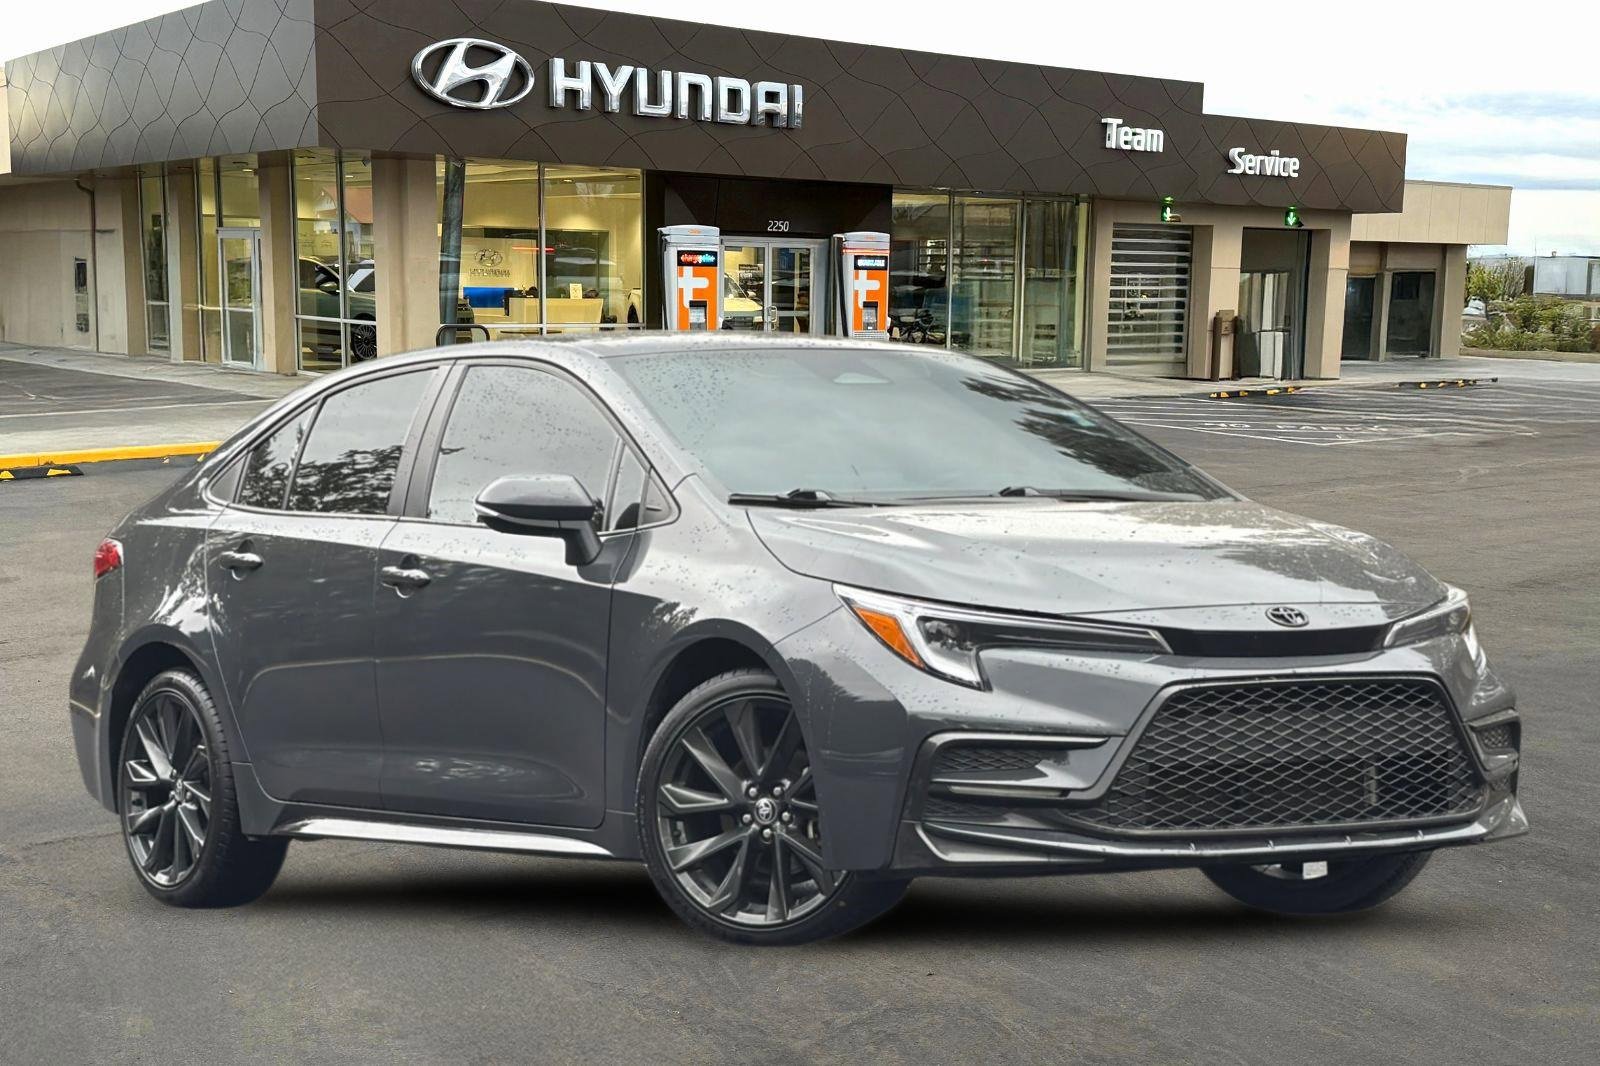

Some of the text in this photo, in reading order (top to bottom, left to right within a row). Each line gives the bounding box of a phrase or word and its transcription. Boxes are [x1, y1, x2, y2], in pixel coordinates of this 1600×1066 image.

[549, 57, 802, 129] HYUNDAI
[1102, 117, 1164, 152] Team
[1228, 147, 1300, 178] Service
[767, 220, 789, 232] 2250
